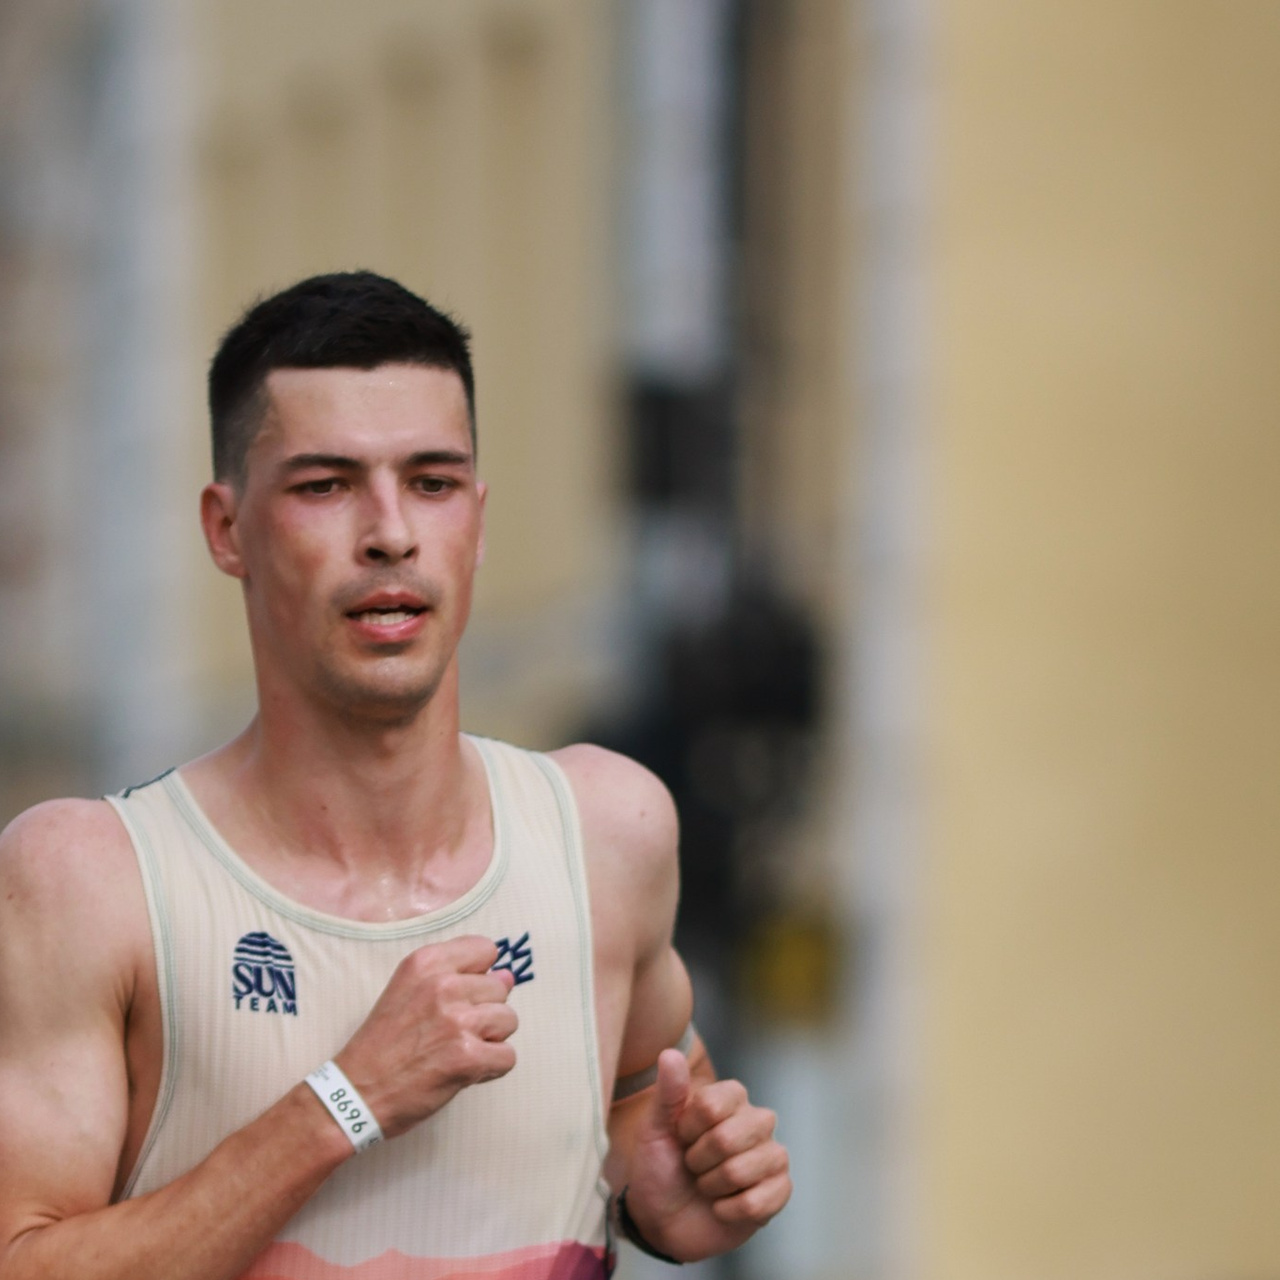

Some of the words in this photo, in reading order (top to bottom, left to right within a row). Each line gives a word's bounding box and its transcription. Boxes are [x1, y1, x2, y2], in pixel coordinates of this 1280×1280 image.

[233, 962, 296, 1001] SUN
[233, 994, 297, 1016] TEAM
[329, 1088, 368, 1134] 8696
